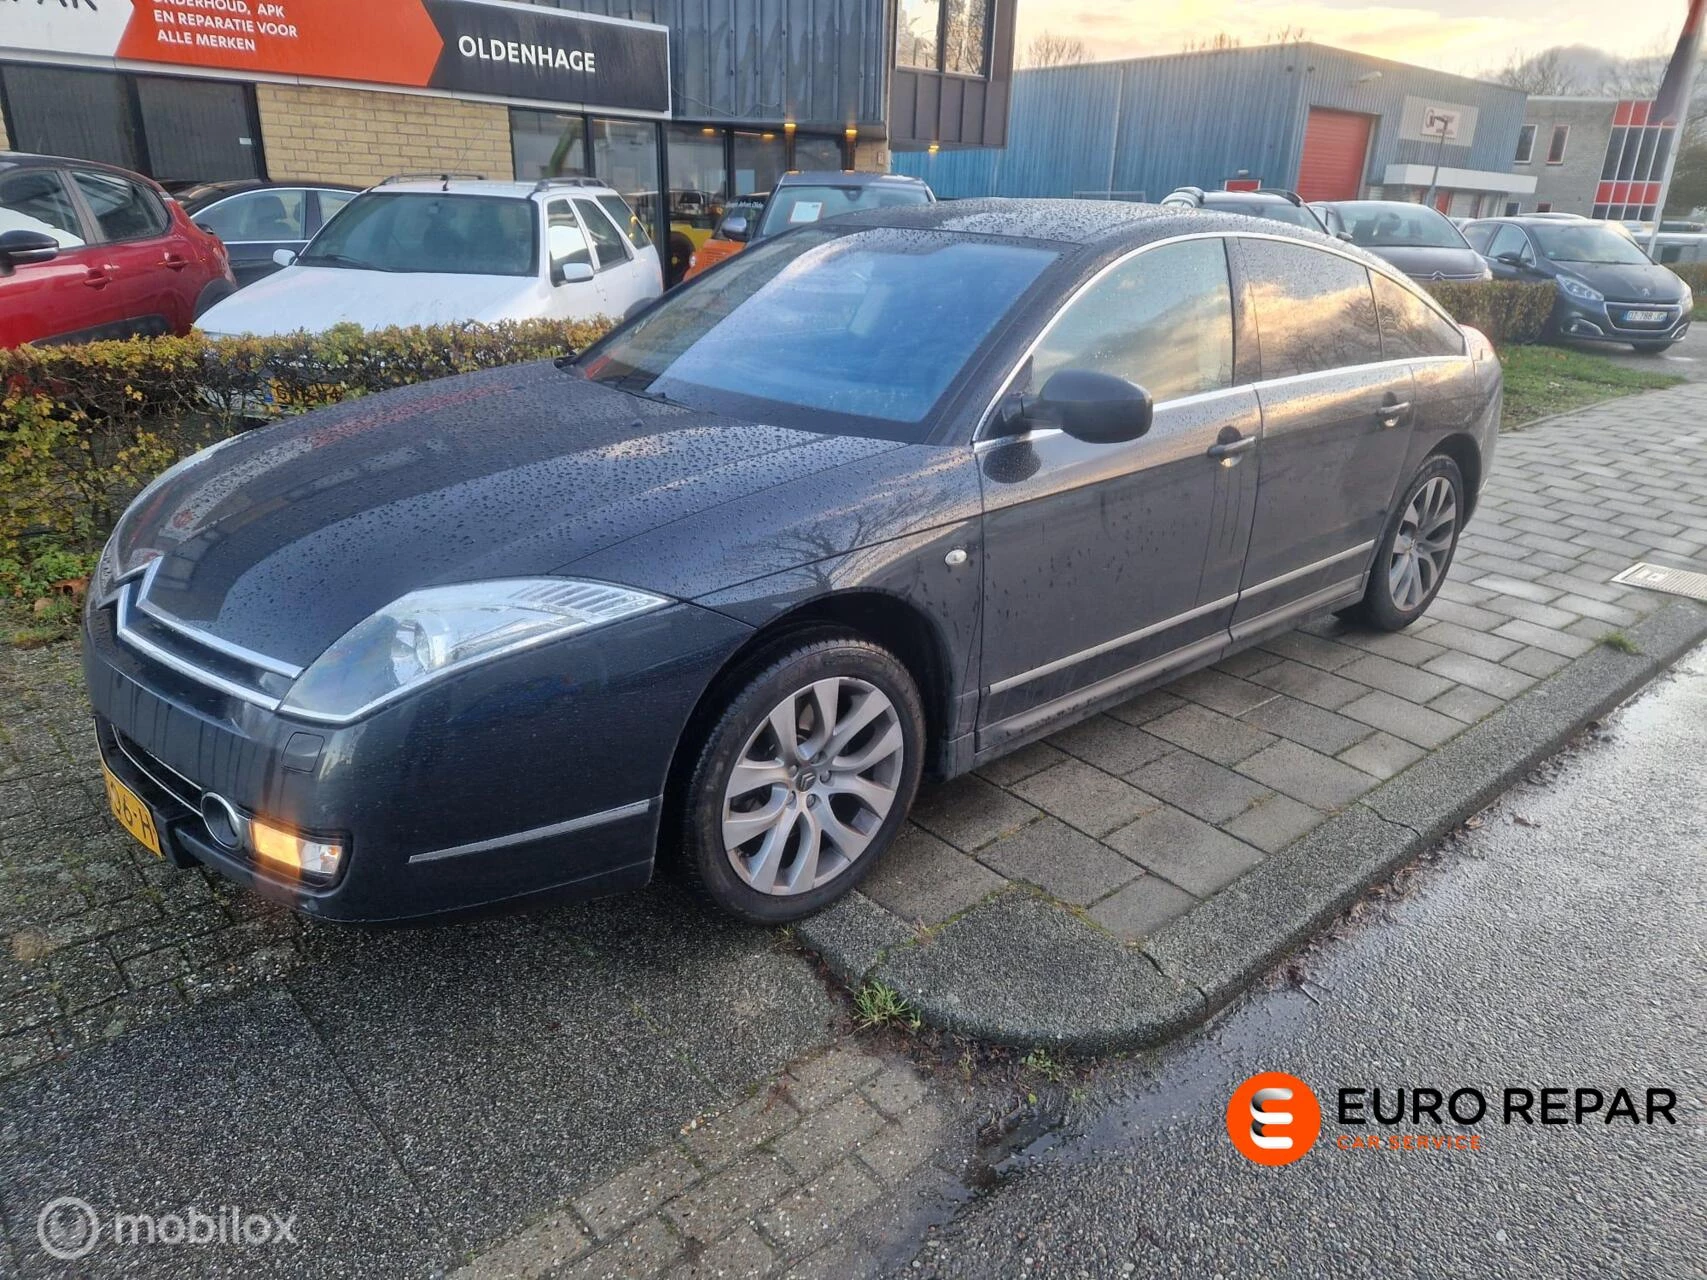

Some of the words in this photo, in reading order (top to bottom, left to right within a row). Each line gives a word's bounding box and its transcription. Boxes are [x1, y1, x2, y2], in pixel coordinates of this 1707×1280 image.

[153, 0, 251, 14] ERHOUD,
[257, 3, 285, 18] APK
[153, 9, 175, 23] EN
[177, 12, 255, 33] REPARATIE
[256, 21, 298, 37] VOOR
[157, 29, 193, 45] ALLE
[196, 33, 256, 51] MERKEN
[458, 35, 596, 73] OLDENHAGE
